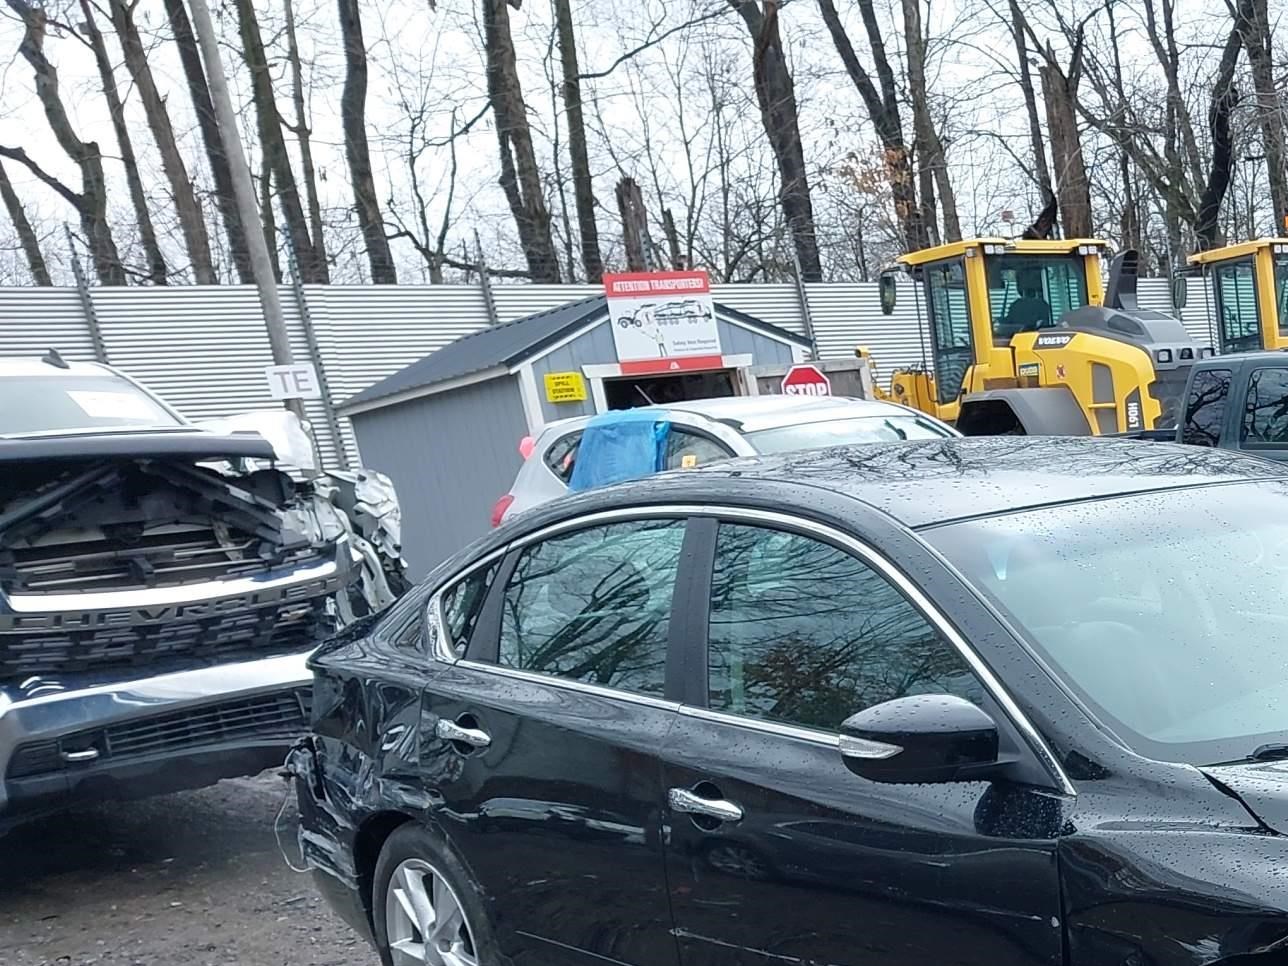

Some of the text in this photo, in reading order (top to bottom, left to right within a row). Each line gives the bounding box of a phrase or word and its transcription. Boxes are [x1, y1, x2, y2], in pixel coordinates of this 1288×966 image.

[1038, 335, 1071, 345] VOLVO
[273, 370, 312, 393] TE
[786, 383, 827, 397] STOP
[1127, 402, 1140, 428] L90H
[12, 577, 338, 632] CHEVROLET
